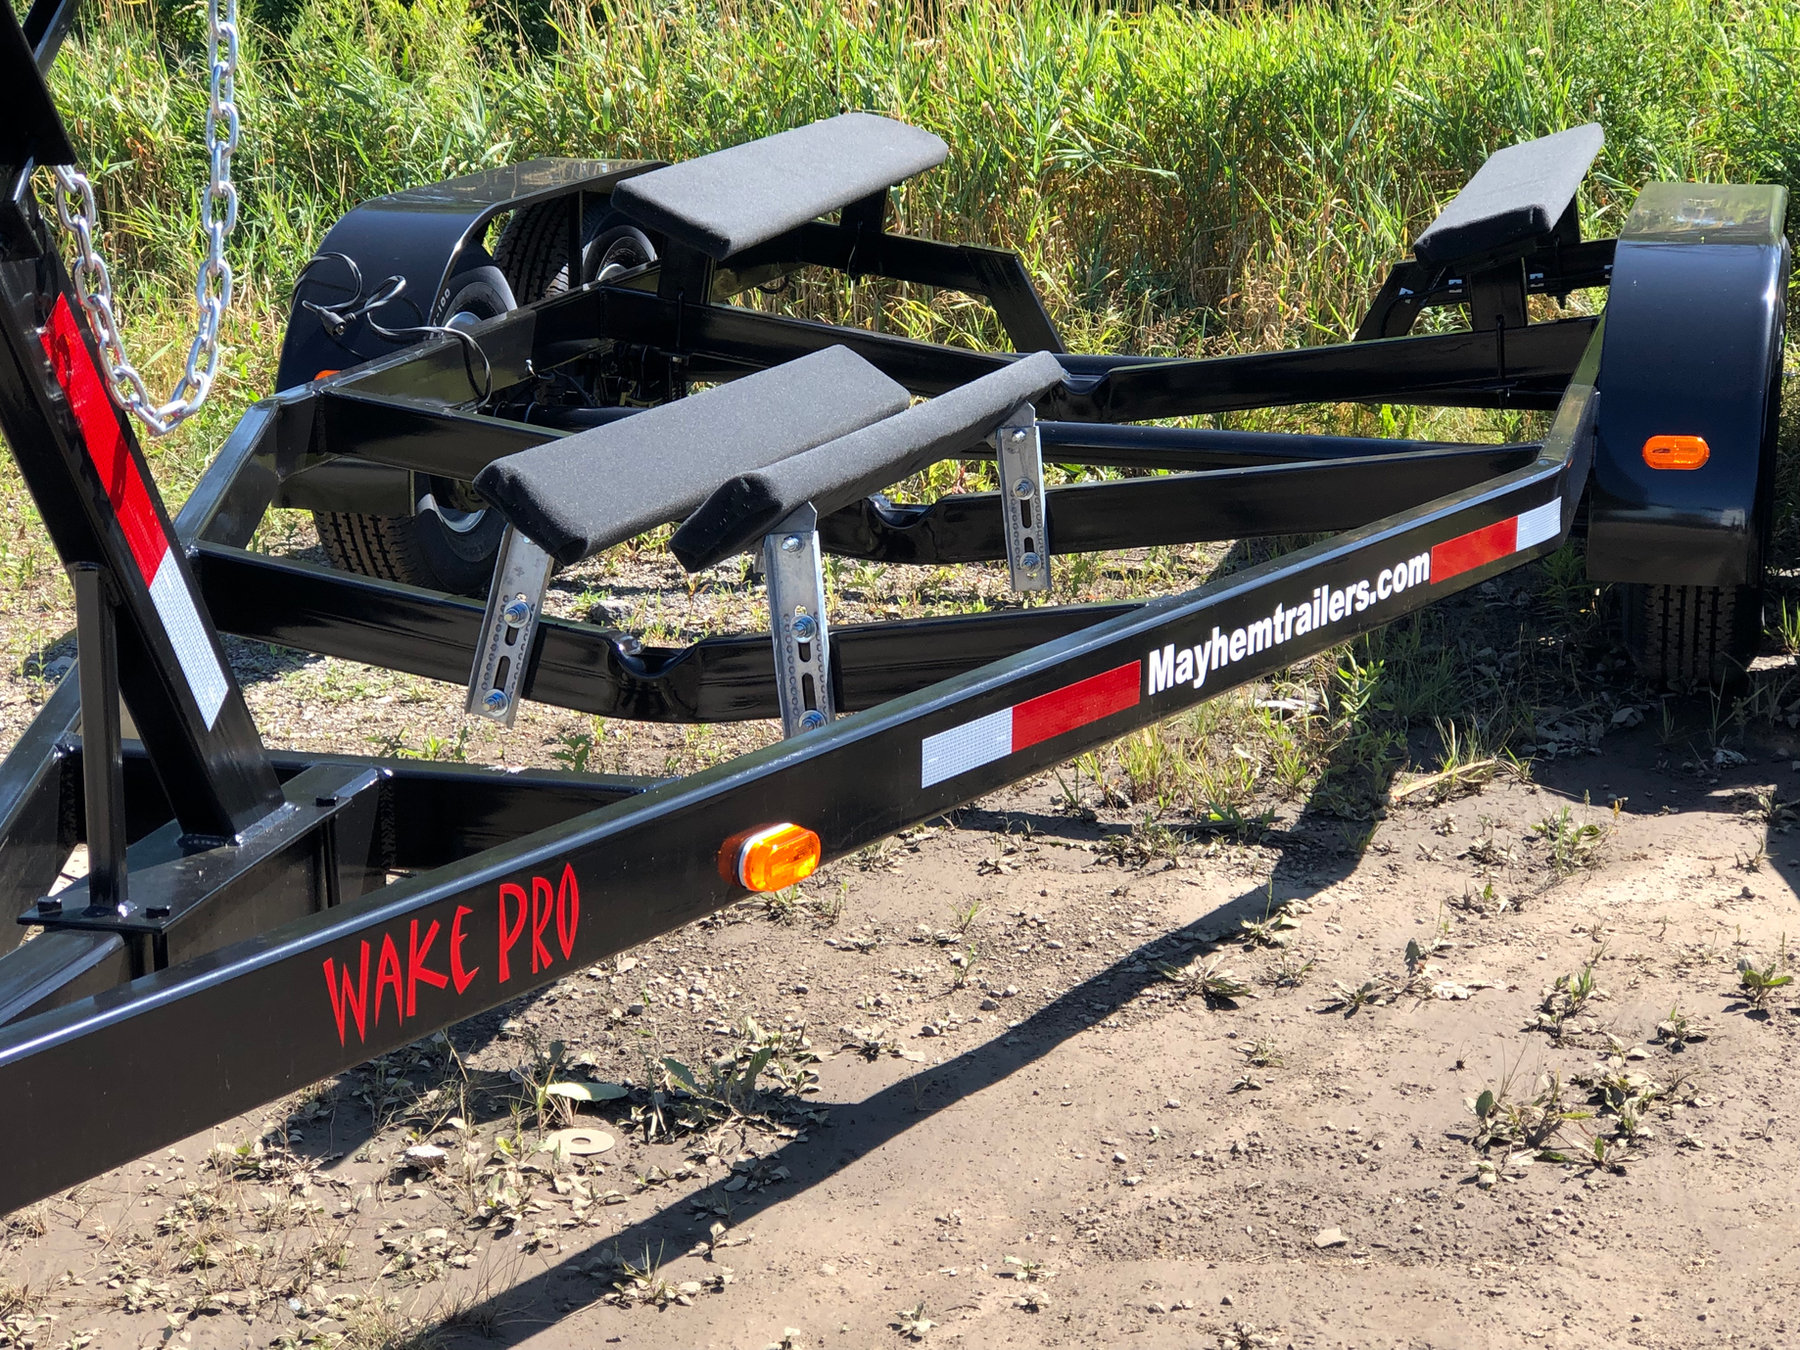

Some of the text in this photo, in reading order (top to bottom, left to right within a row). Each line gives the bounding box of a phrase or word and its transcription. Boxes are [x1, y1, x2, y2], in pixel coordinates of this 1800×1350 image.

[1148, 551, 1430, 696] Mayhemtrailers.com
[323, 862, 580, 1047] WAKE PRO
